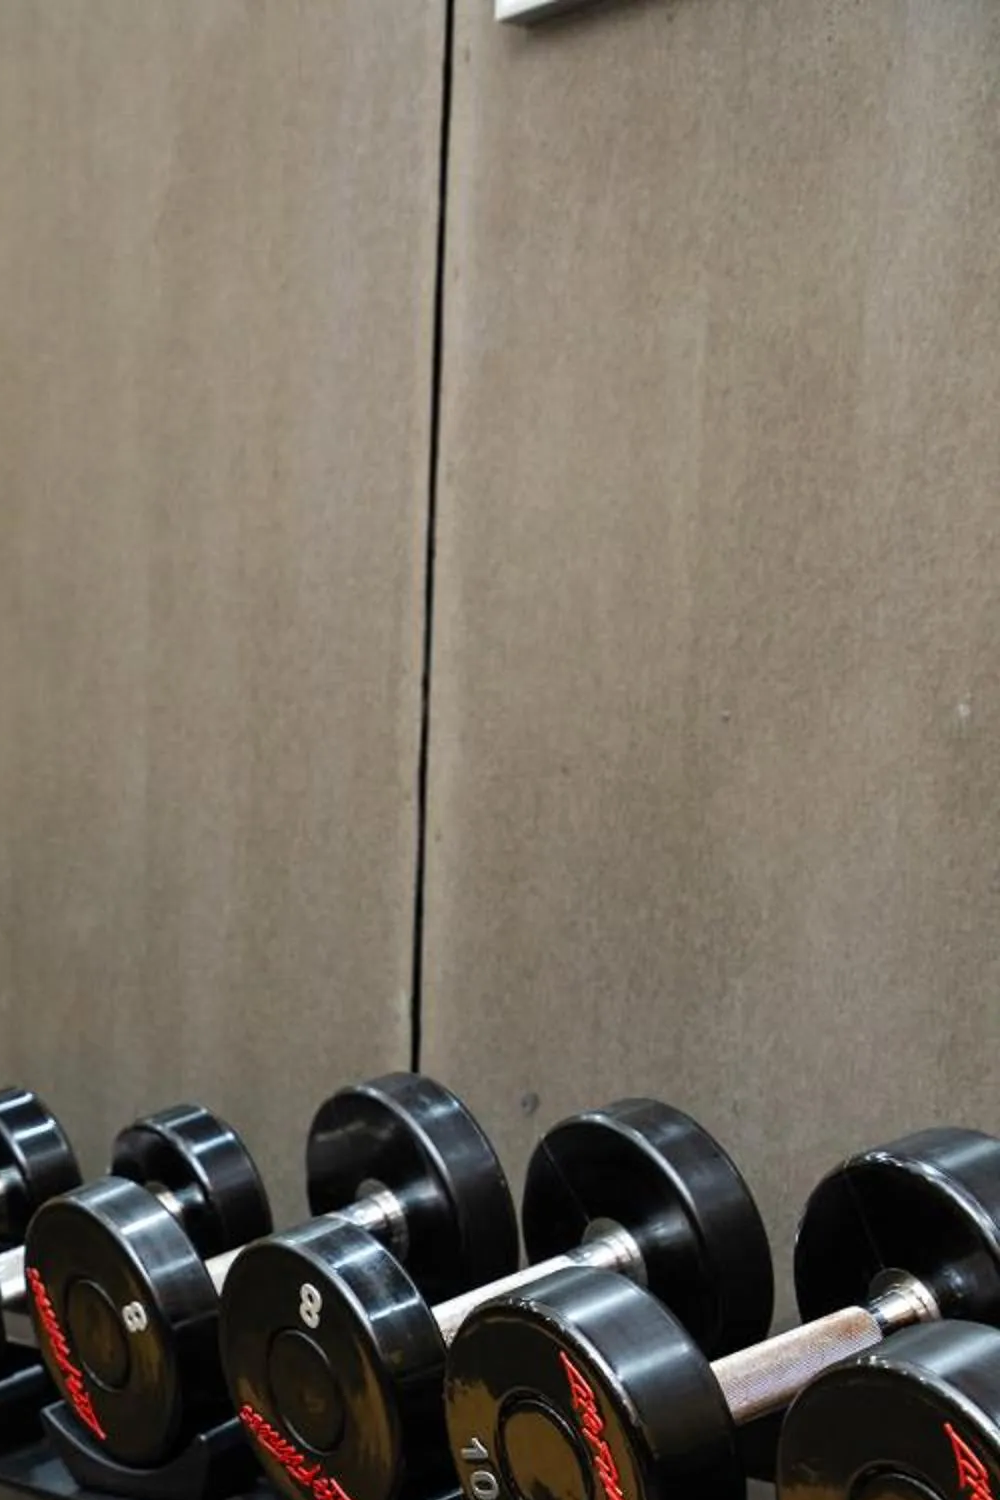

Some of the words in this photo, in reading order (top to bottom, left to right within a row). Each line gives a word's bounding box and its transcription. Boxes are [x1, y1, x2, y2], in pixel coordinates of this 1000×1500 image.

[121, 1300, 149, 1333] 8
[298, 1282, 323, 1330] 8
[460, 1436, 499, 1500] 10
